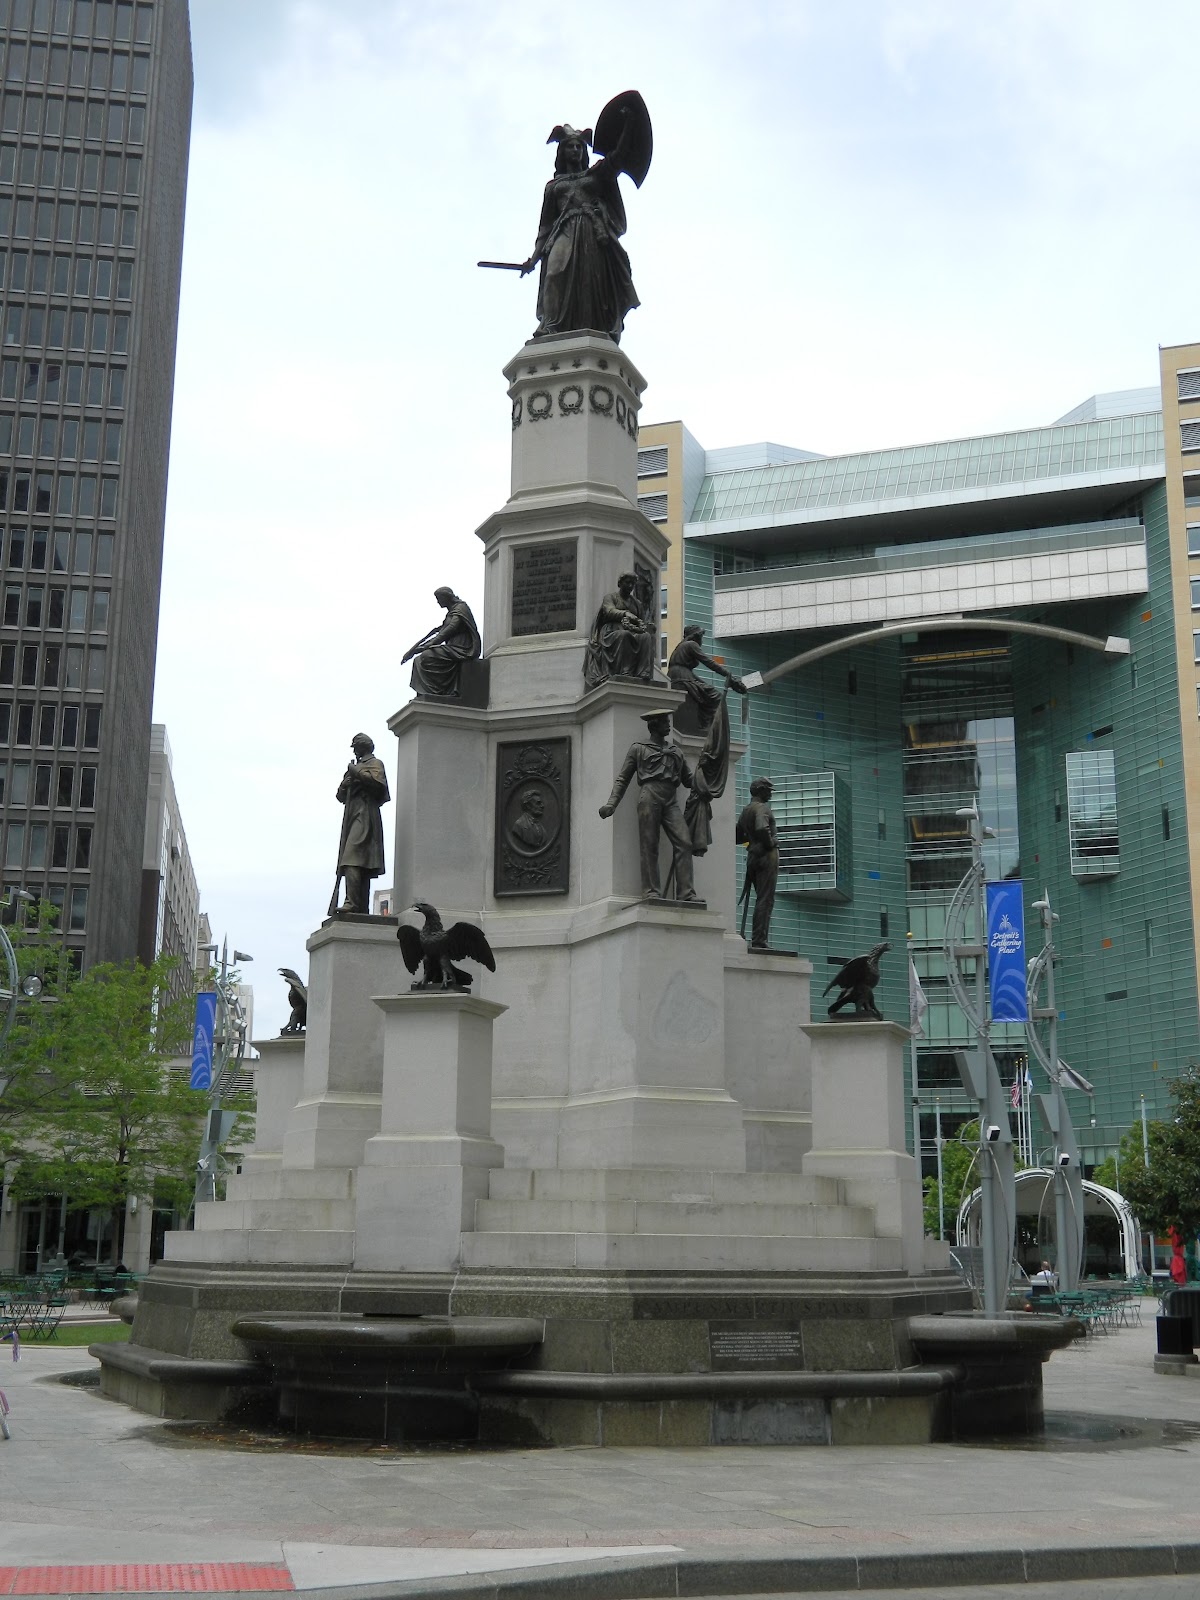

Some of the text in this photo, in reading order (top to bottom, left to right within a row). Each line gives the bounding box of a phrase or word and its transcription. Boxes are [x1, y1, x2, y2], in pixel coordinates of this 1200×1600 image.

[993, 932, 1020, 940] Detroit's
[990, 939, 1022, 949] Gathering
[998, 946, 1016, 954] Place
[637, 1301, 719, 1314] CAMPUS
